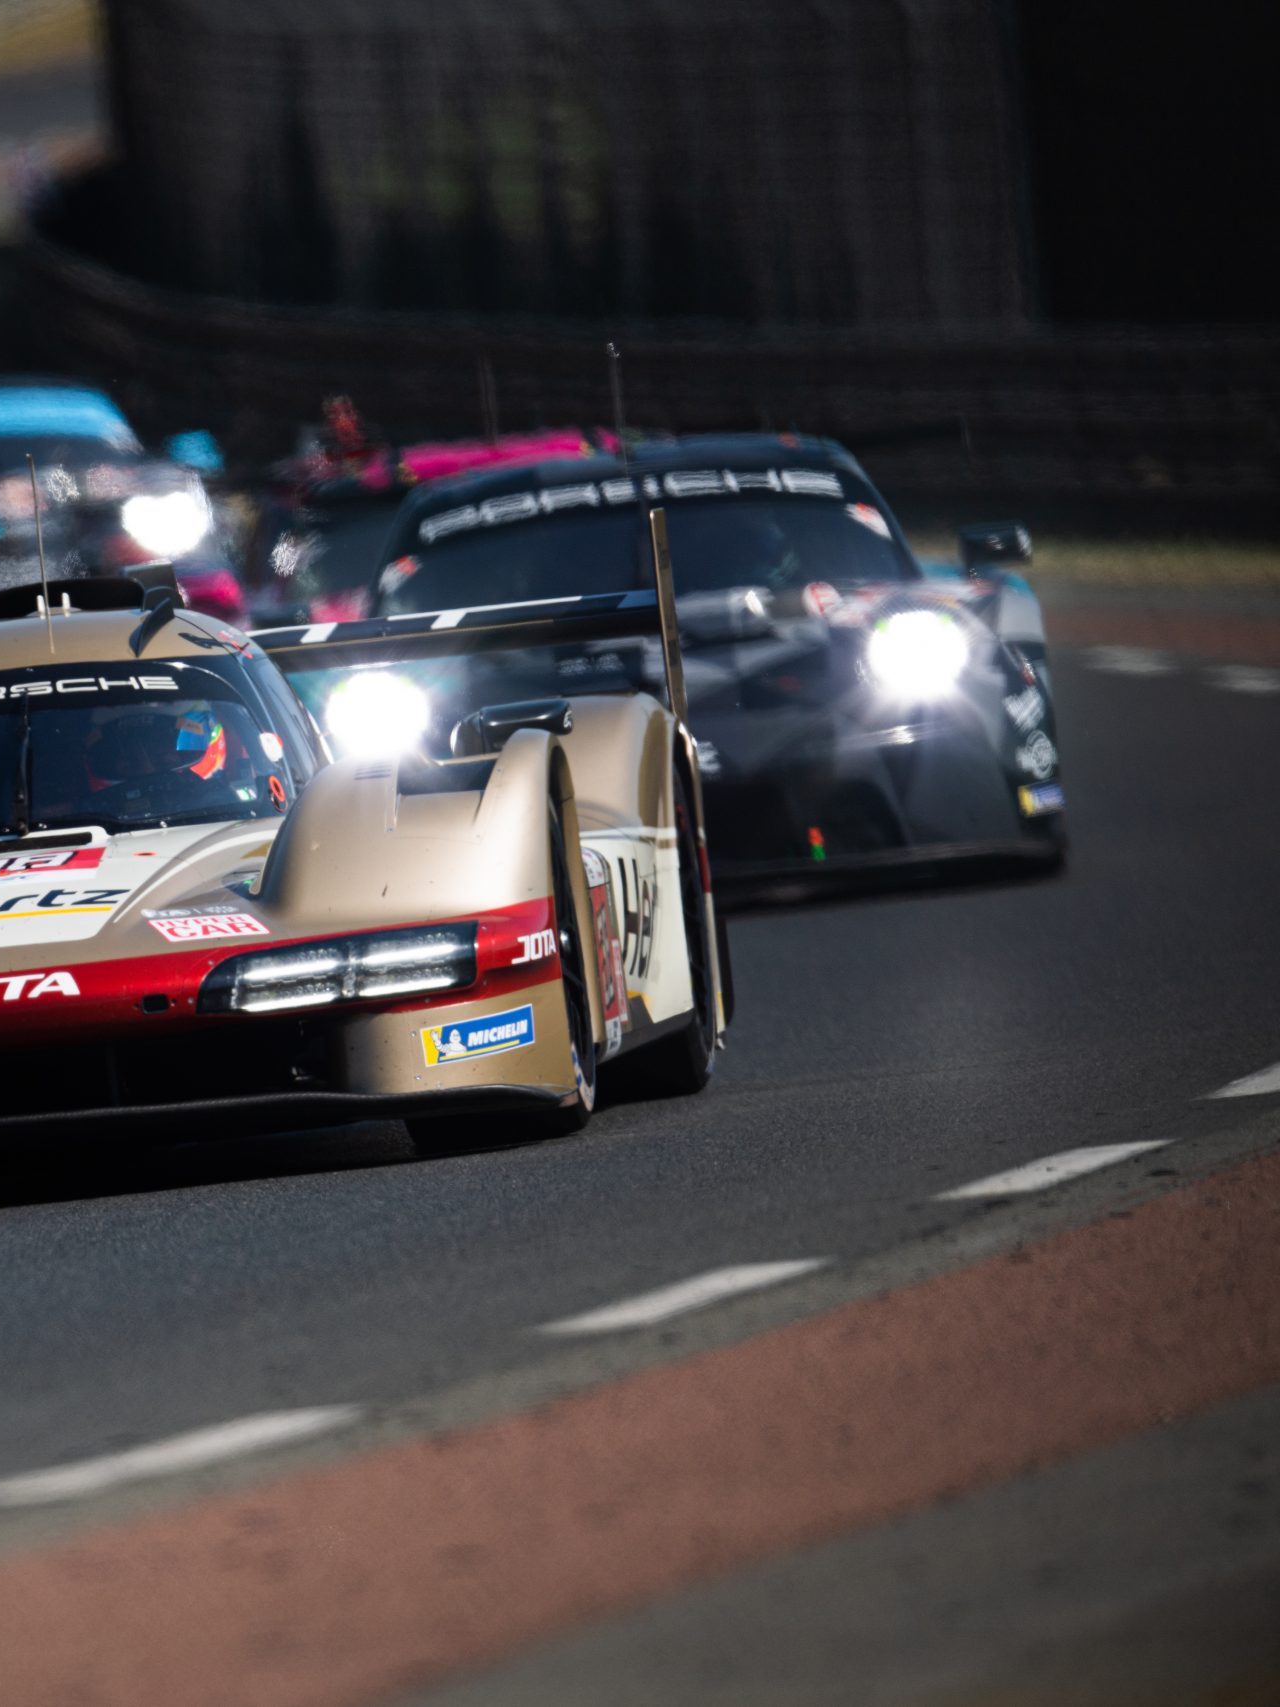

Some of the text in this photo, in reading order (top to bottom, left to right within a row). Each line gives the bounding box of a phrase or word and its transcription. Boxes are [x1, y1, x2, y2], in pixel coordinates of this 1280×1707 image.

[156, 914, 245, 928] HYPER
[167, 922, 261, 938] CAR
[511, 928, 557, 964] JOTA
[468, 1019, 528, 1046] MICHELIN
